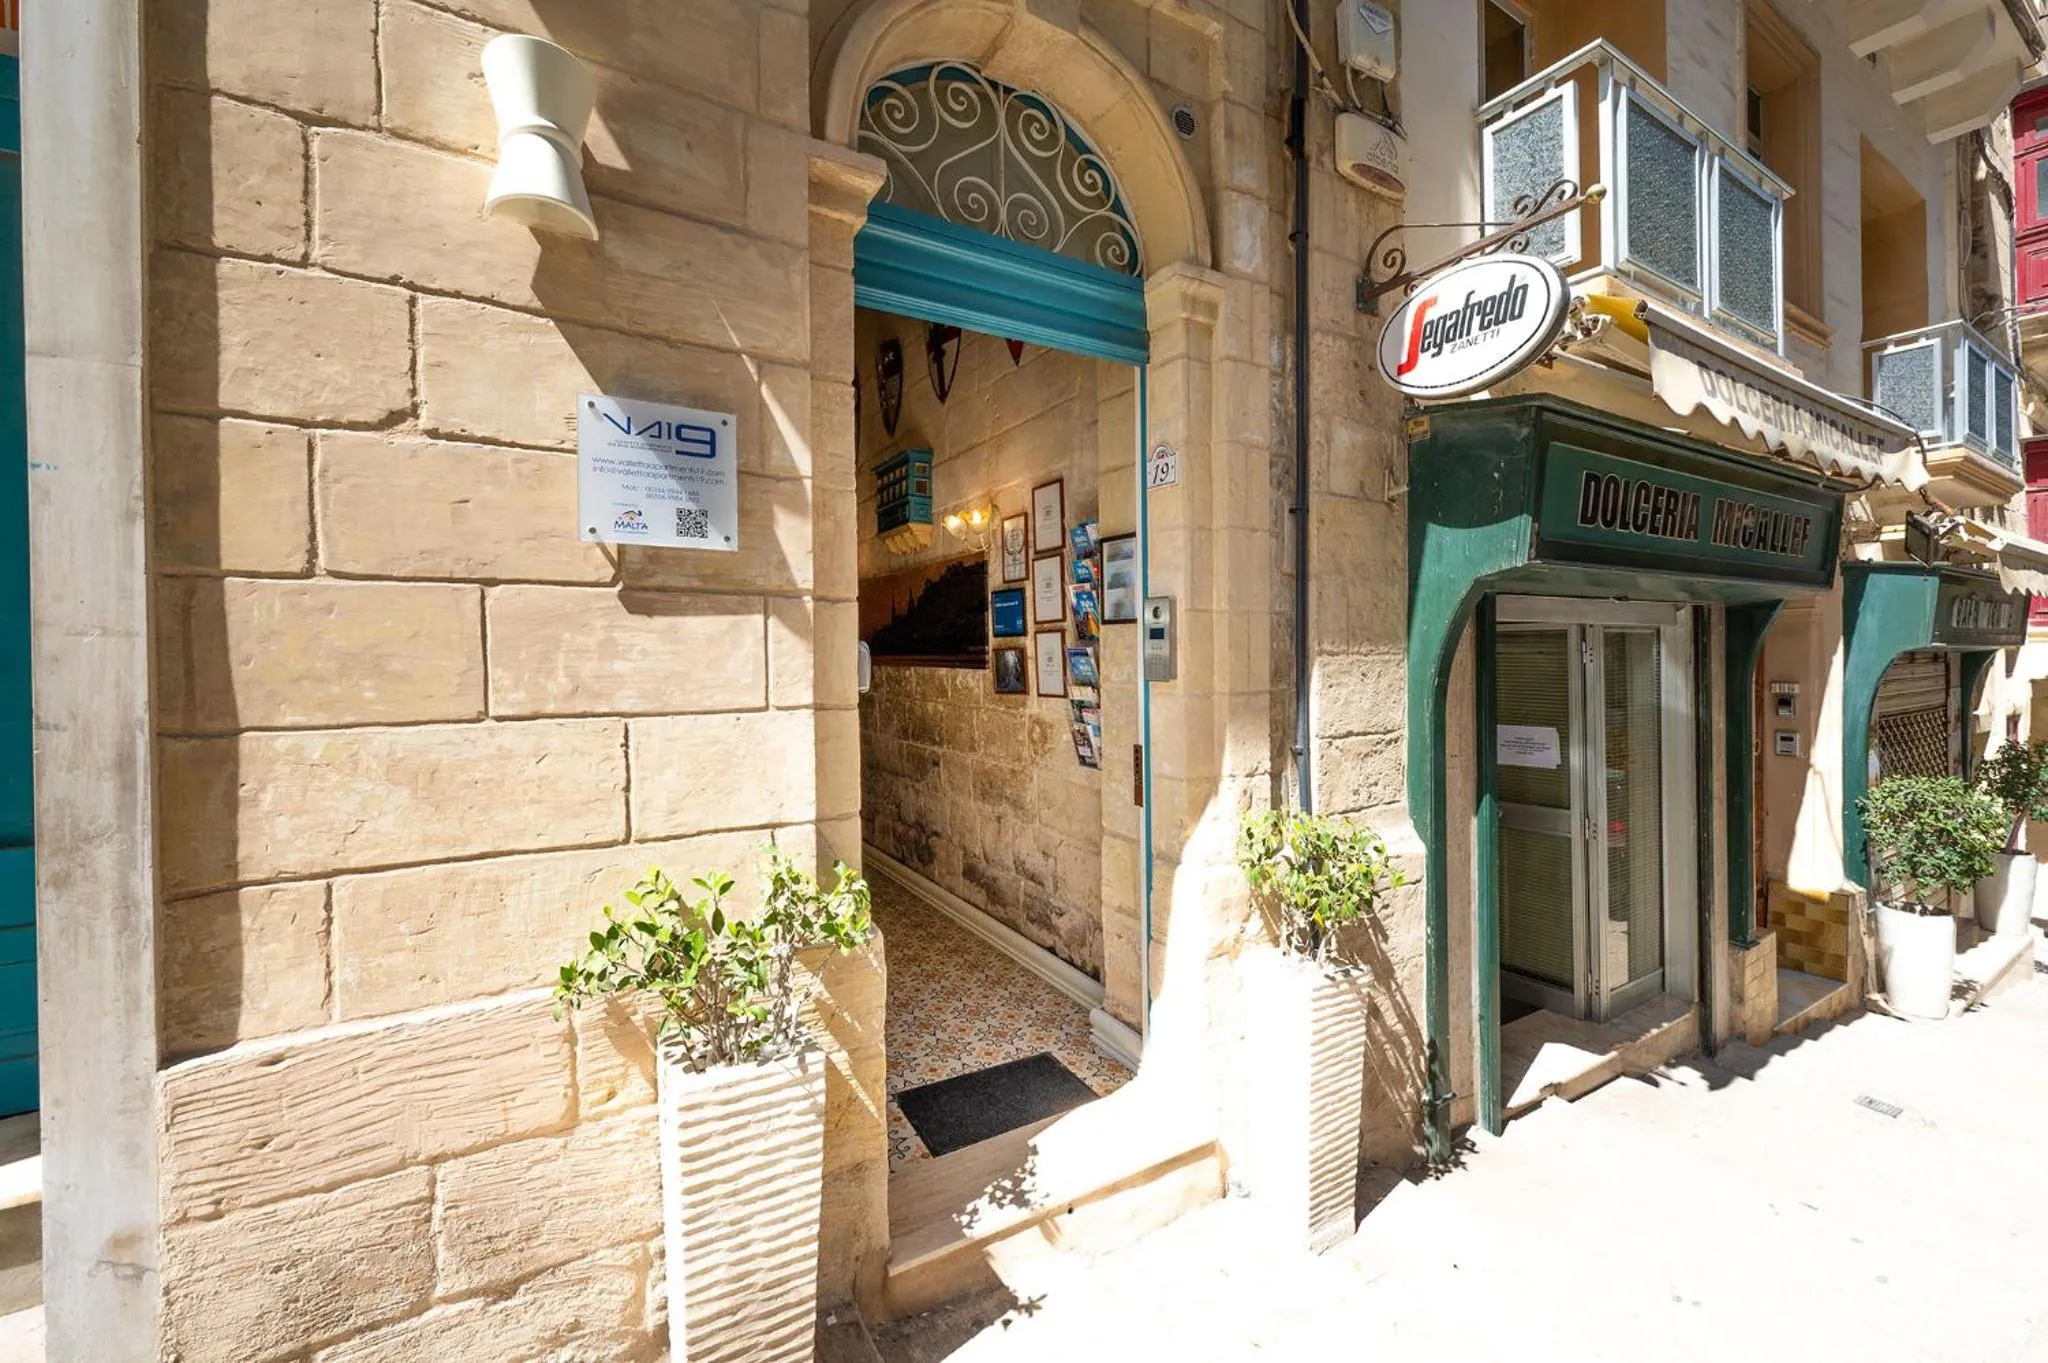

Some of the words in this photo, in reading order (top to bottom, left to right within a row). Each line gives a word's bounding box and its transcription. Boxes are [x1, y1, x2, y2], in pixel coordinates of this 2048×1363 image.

[1397, 274, 1529, 377] Segafredo
[1450, 330, 1502, 354] ZANETTI
[603, 412, 717, 459] VA19
[1697, 360, 1804, 435] DOLCERIA
[1807, 408, 1885, 465] MICALLEF
[1153, 462, 1170, 485] 19
[614, 520, 648, 531] MALTA
[1577, 470, 1700, 543] DOLCERIA
[1711, 496, 1811, 558] MICALLEF
